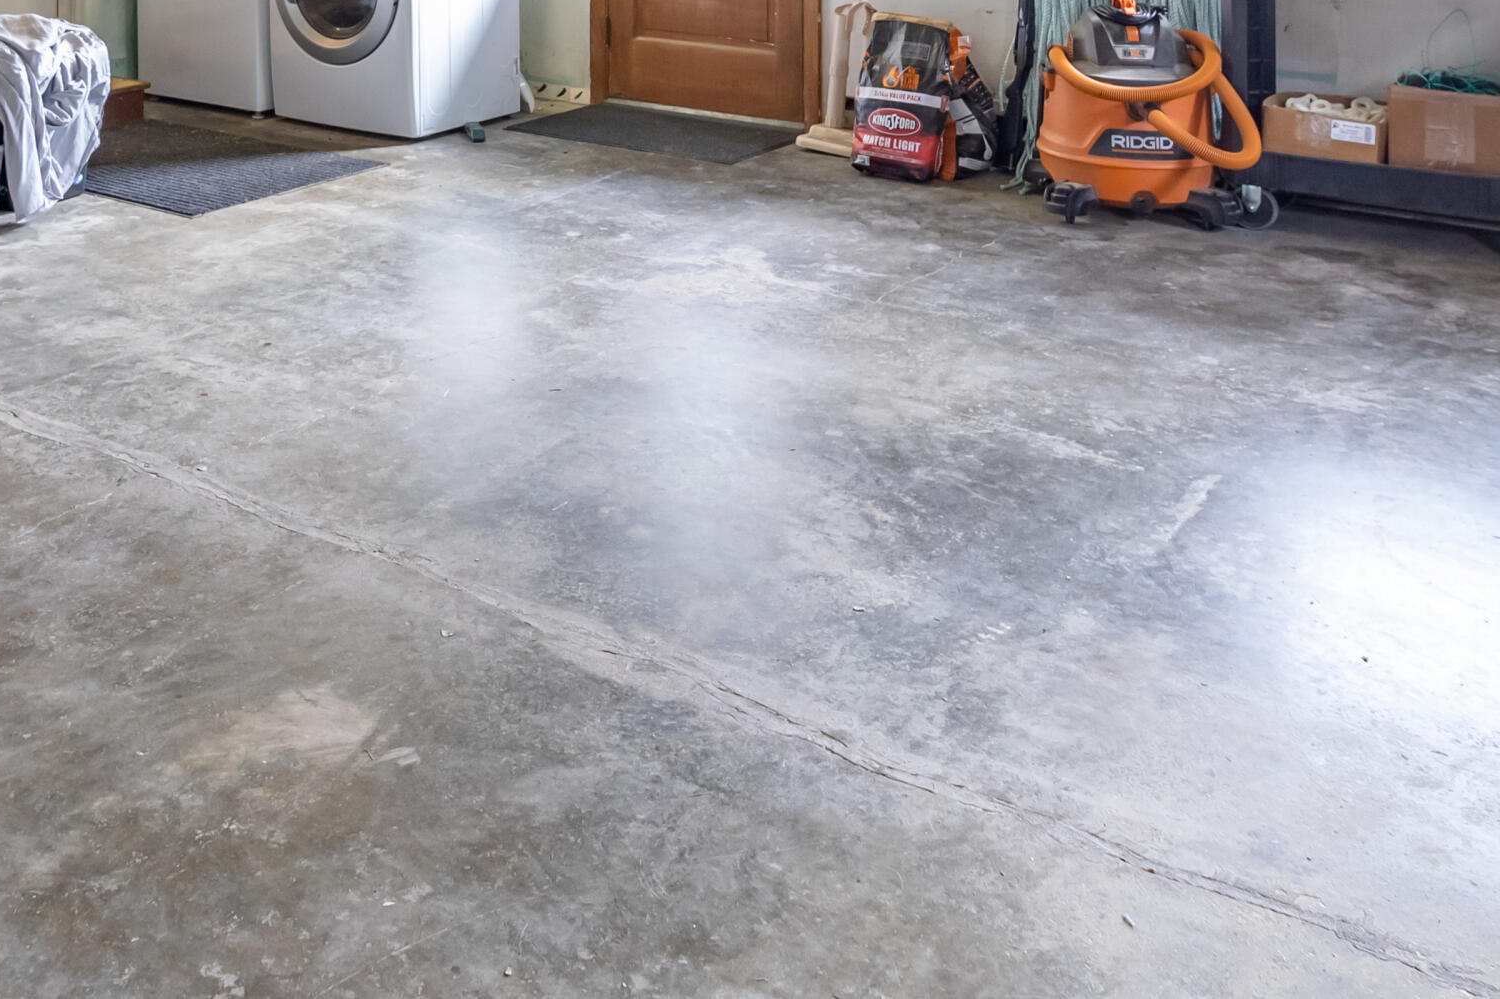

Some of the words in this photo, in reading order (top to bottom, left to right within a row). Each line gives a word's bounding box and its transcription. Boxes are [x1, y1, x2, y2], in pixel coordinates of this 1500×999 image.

[907, 94, 922, 102] PACK
[872, 113, 916, 131] KINGSFORD
[862, 134, 891, 148] MATCH
[893, 138, 922, 153] LIGHT
[1111, 134, 1174, 151] RIDGID
